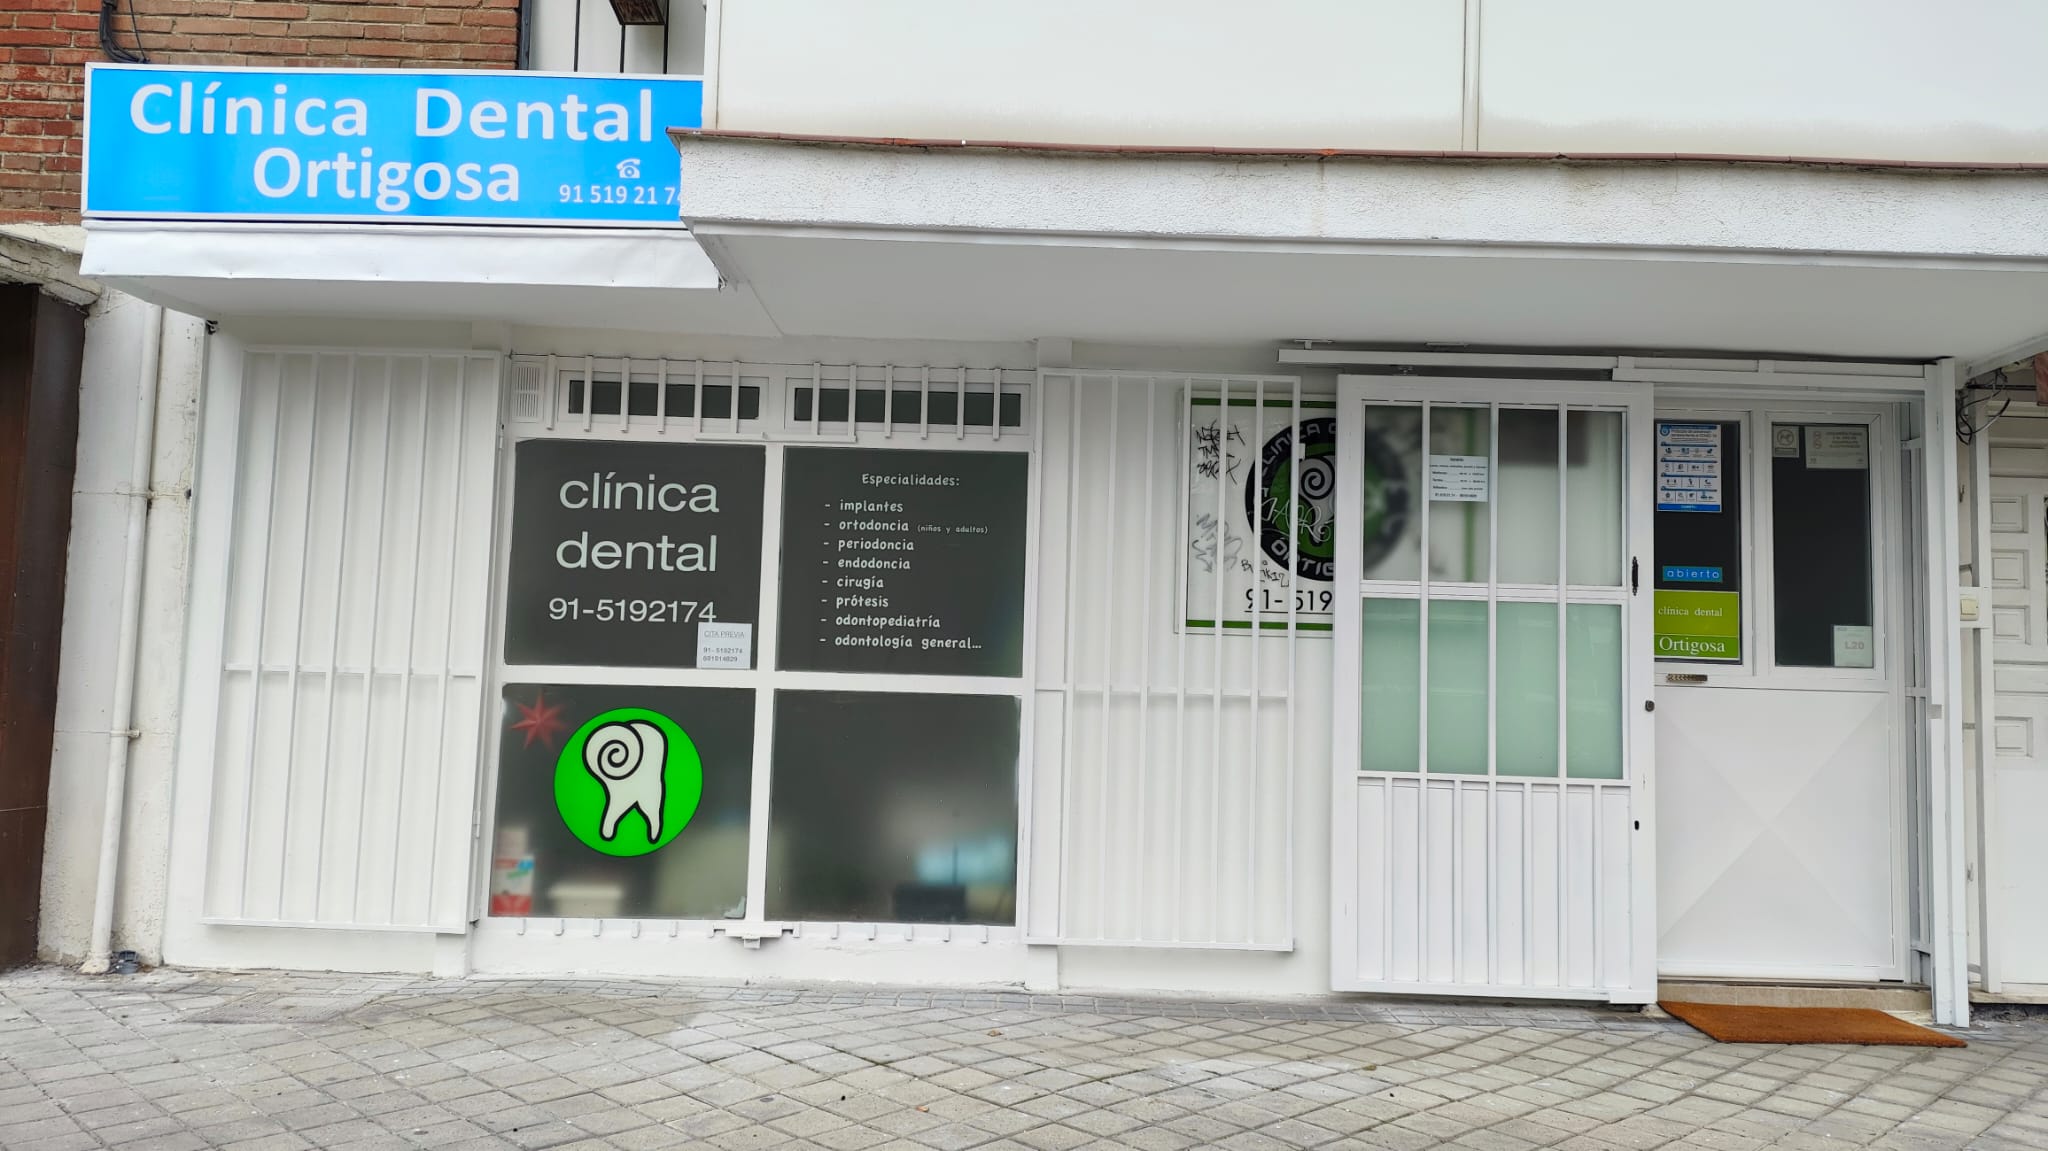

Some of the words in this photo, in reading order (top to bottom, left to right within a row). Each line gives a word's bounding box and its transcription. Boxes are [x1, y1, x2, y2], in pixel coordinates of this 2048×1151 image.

[130, 81, 367, 136] Clínica
[415, 88, 652, 142] Dental
[252, 147, 519, 212] Ortigosa
[559, 184, 583, 204] 91
[590, 185, 628, 204] 519
[634, 186, 658, 205] 21
[664, 187, 681, 205] 7
[861, 473, 961, 487] Especialidades:
[559, 472, 720, 513] clínica
[840, 499, 904, 514] implantes
[838, 519, 909, 532] ortodoncia
[555, 531, 717, 573] dental
[838, 538, 914, 552] periodoncia
[837, 557, 911, 570] endodoncia
[1666, 568, 1720, 579] abierto
[836, 575, 884, 590] cirugía
[836, 594, 889, 609] prótesis
[549, 597, 717, 623] 91-5192174
[1658, 606, 1689, 616] clínica
[1694, 607, 1723, 617] dental
[835, 614, 941, 629] odontopediatría
[703, 630, 720, 639] CITA
[835, 634, 913, 649] odontología
[1659, 636, 1726, 655] Ortigosa
